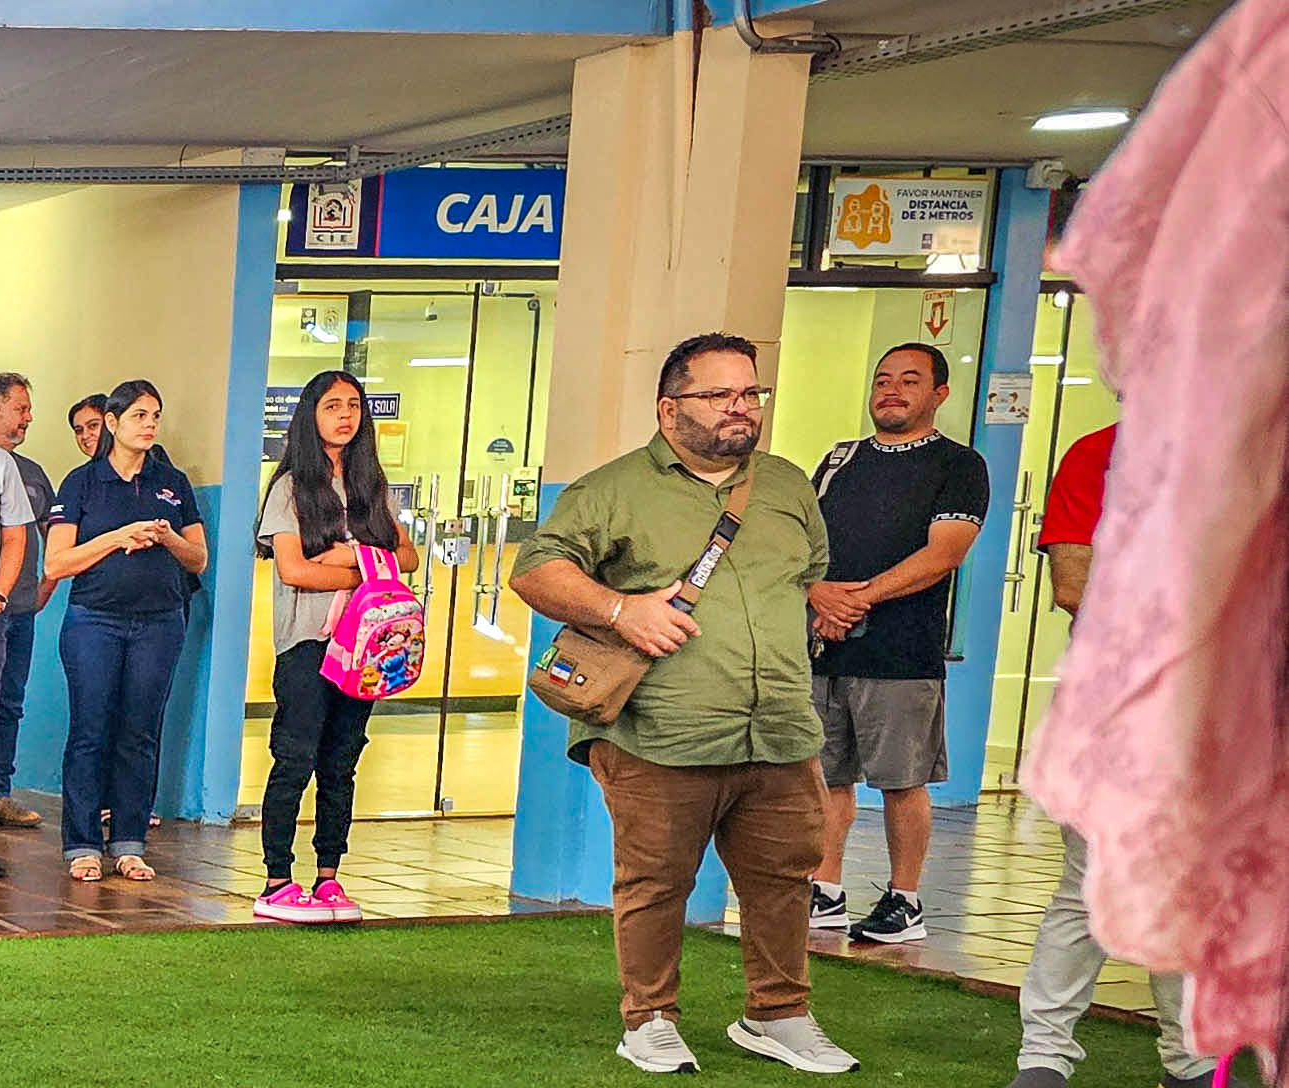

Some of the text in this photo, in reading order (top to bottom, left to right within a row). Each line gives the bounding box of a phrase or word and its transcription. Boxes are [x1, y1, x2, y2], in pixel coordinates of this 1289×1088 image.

[897, 188, 982, 198] FAVOR MANTENER
[909, 200, 968, 210] DISTANCIA
[436, 192, 554, 234] CAJA
[902, 210, 974, 220] DE 2 METROS
[374, 400, 395, 413] SOLA
